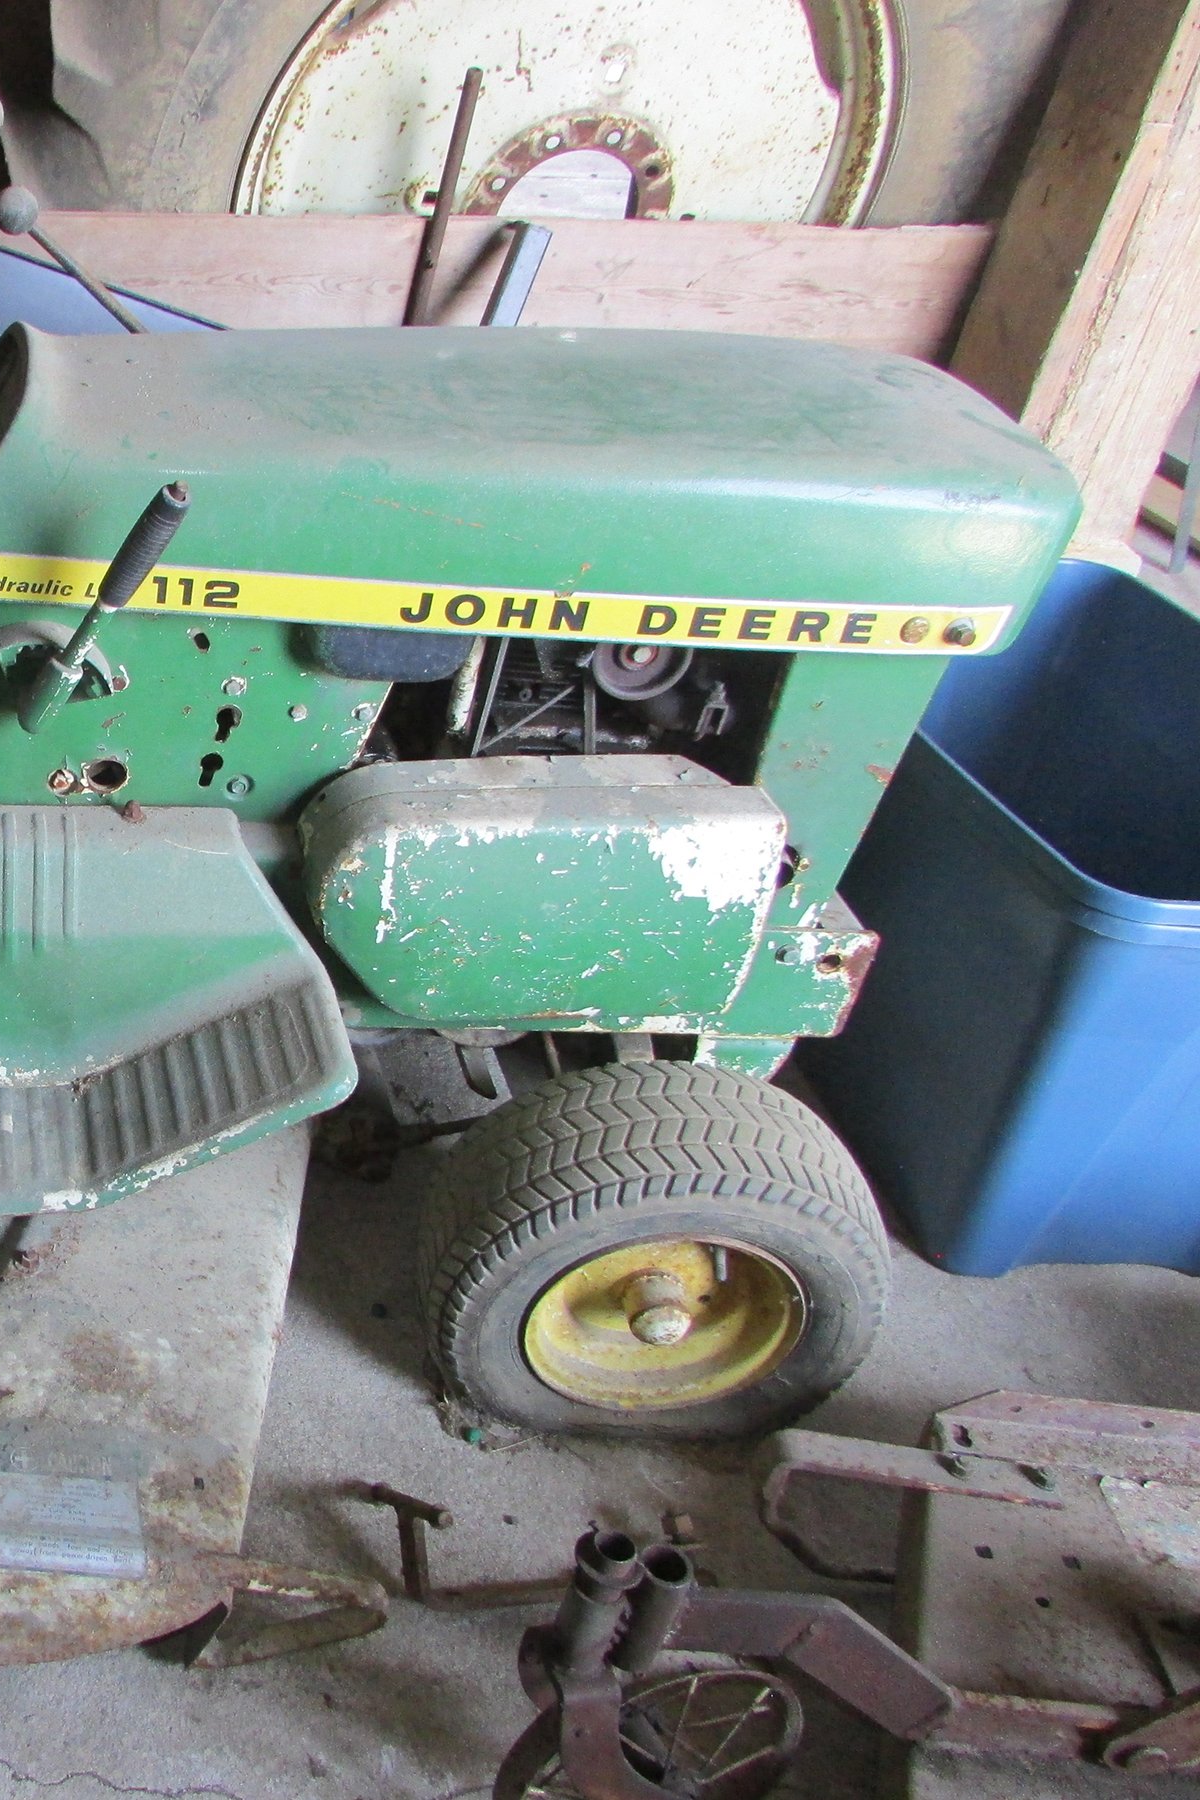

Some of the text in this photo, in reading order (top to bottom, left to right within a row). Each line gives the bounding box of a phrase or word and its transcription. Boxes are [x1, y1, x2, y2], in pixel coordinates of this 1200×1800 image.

[153, 576, 240, 609] 112
[399, 592, 879, 645] JOHN DEERE
